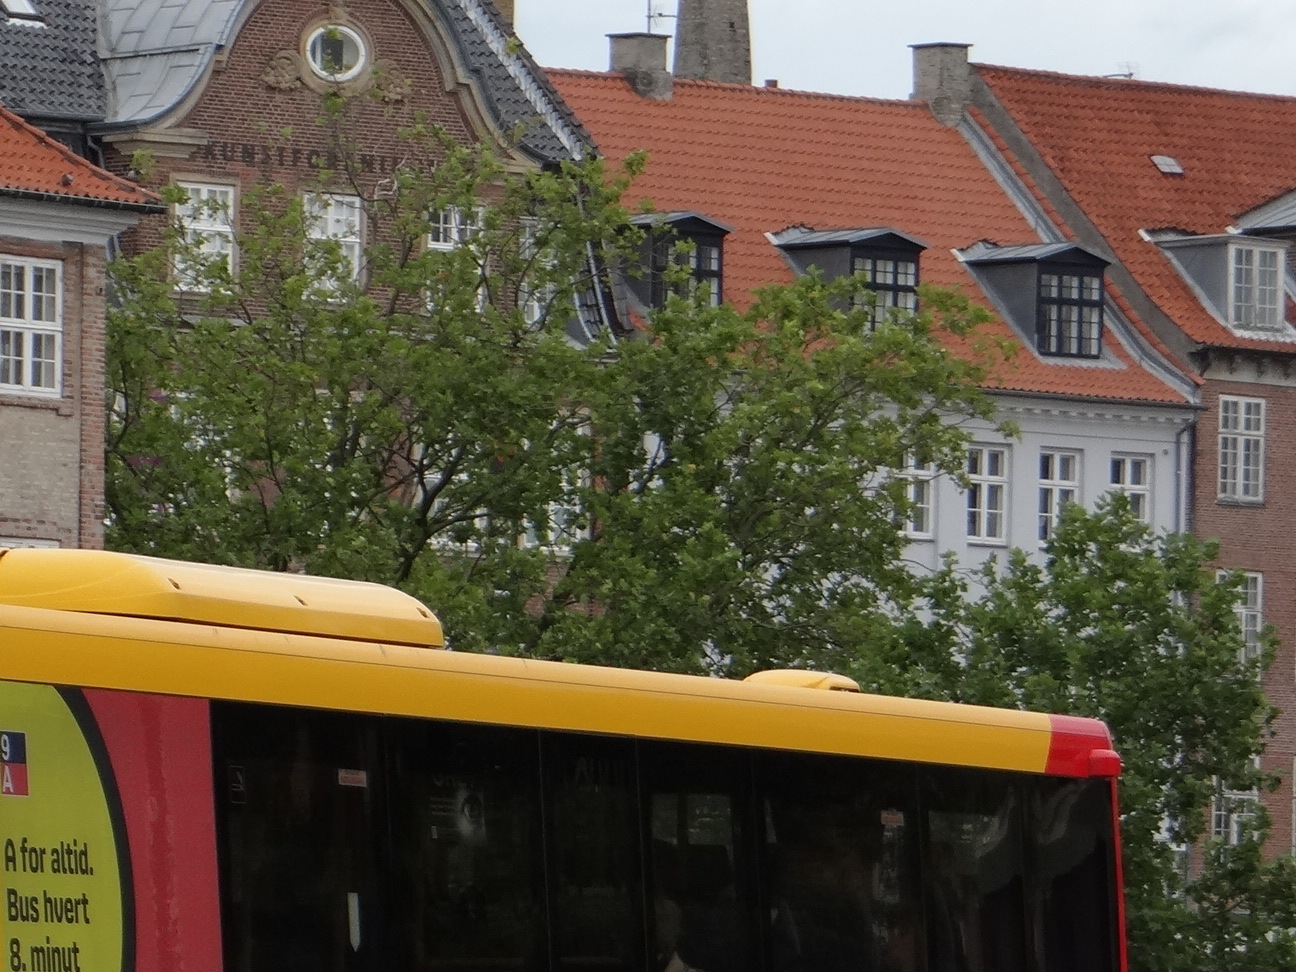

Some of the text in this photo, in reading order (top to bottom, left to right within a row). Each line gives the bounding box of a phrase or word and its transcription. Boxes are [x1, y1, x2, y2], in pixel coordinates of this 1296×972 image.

[0, 734, 10, 761] 9
[2, 765, 14, 794] A
[5, 836, 94, 876] A for altid.
[7, 887, 91, 924] Bus hvert
[9, 935, 81, 972] 8. minut
